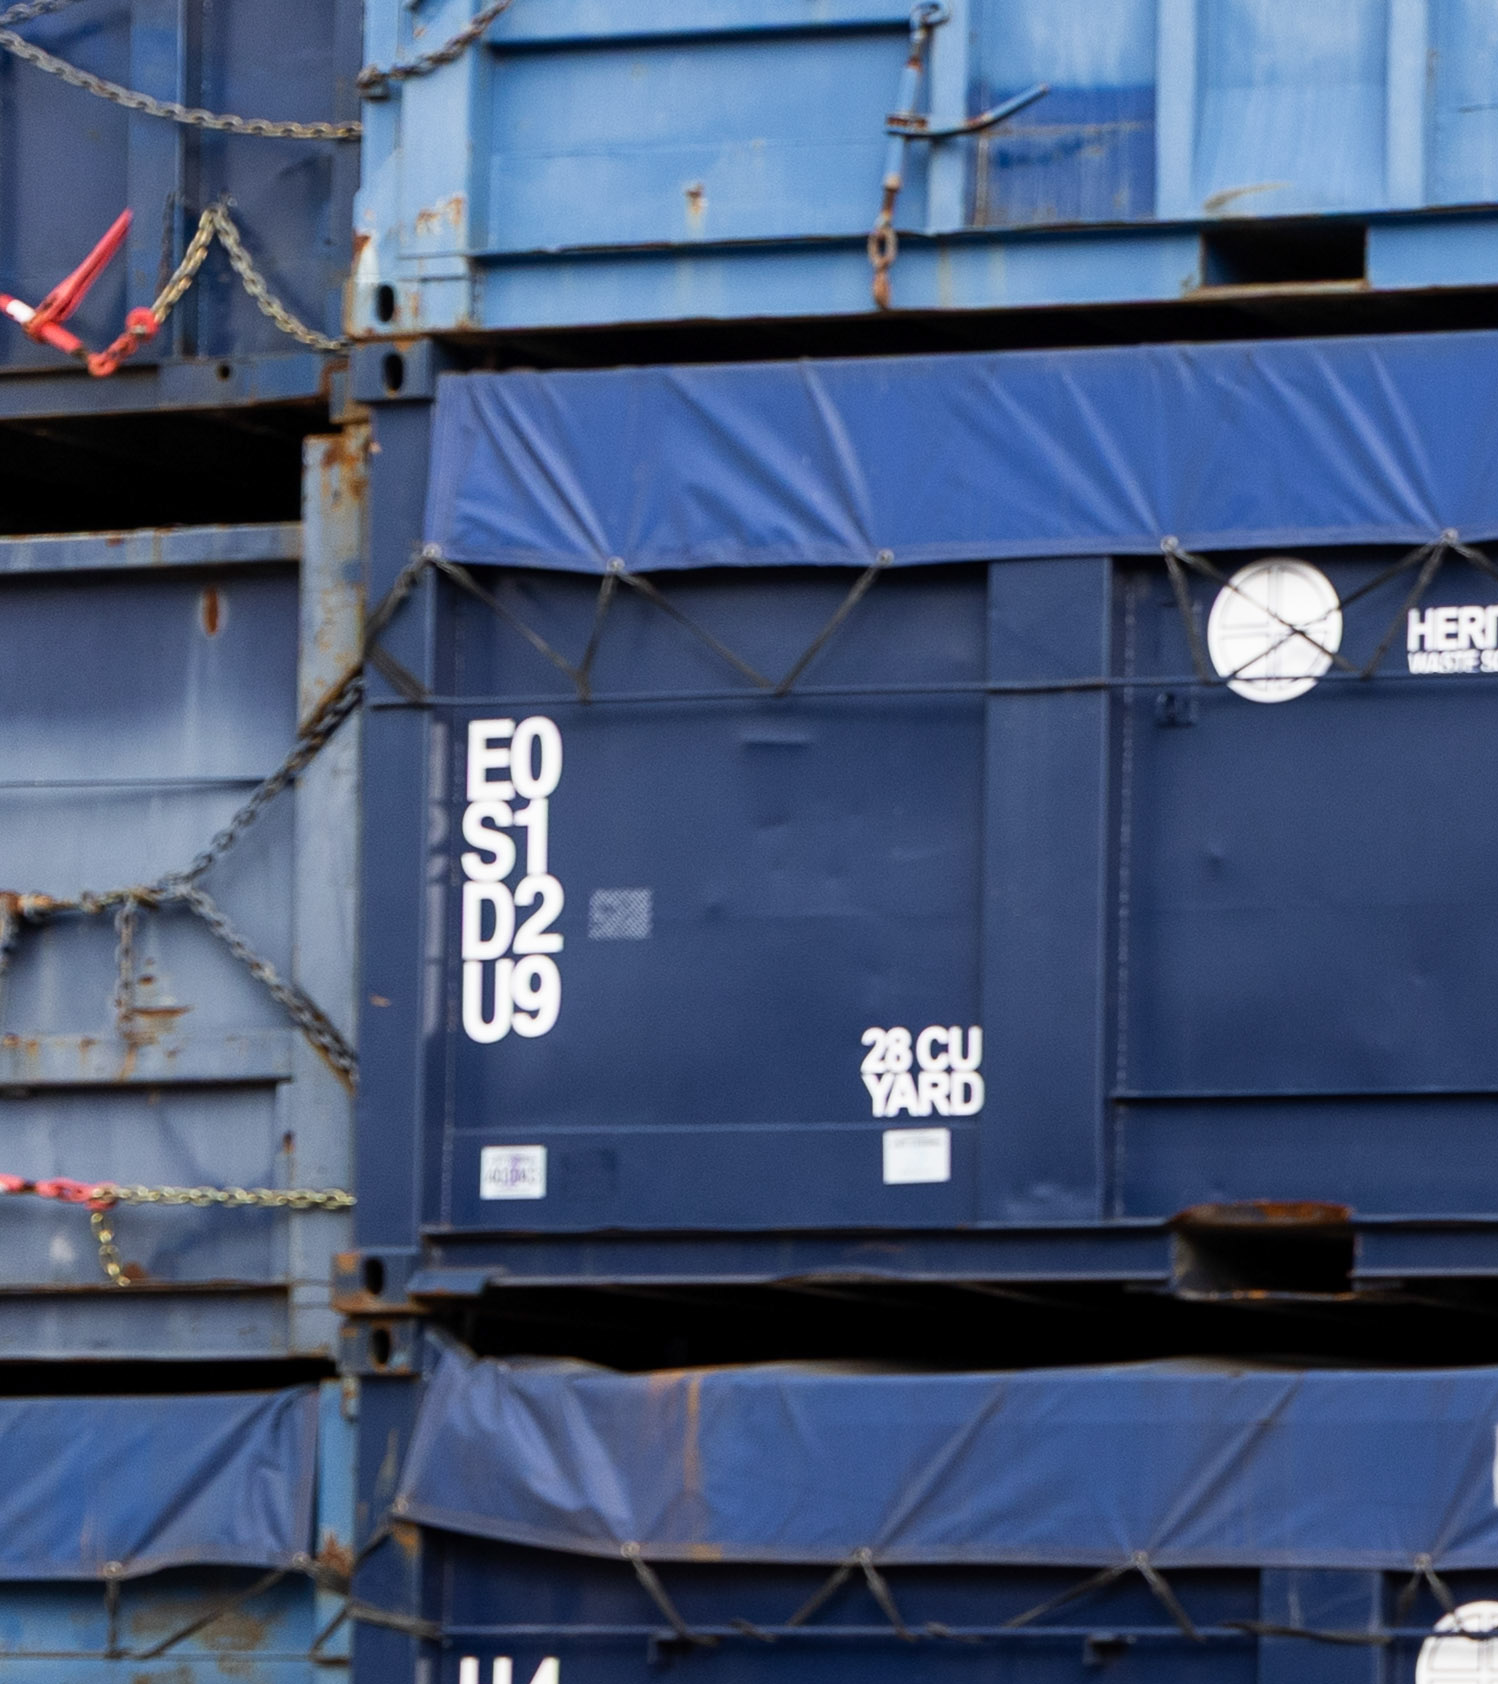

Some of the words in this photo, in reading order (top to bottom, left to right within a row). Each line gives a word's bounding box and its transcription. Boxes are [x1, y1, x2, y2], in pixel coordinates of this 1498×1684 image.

[1408, 650, 1480, 674] WASTE
[860, 1026, 912, 1073] 28
[915, 1026, 983, 1071] CU
[861, 1070, 984, 1117] YARD
